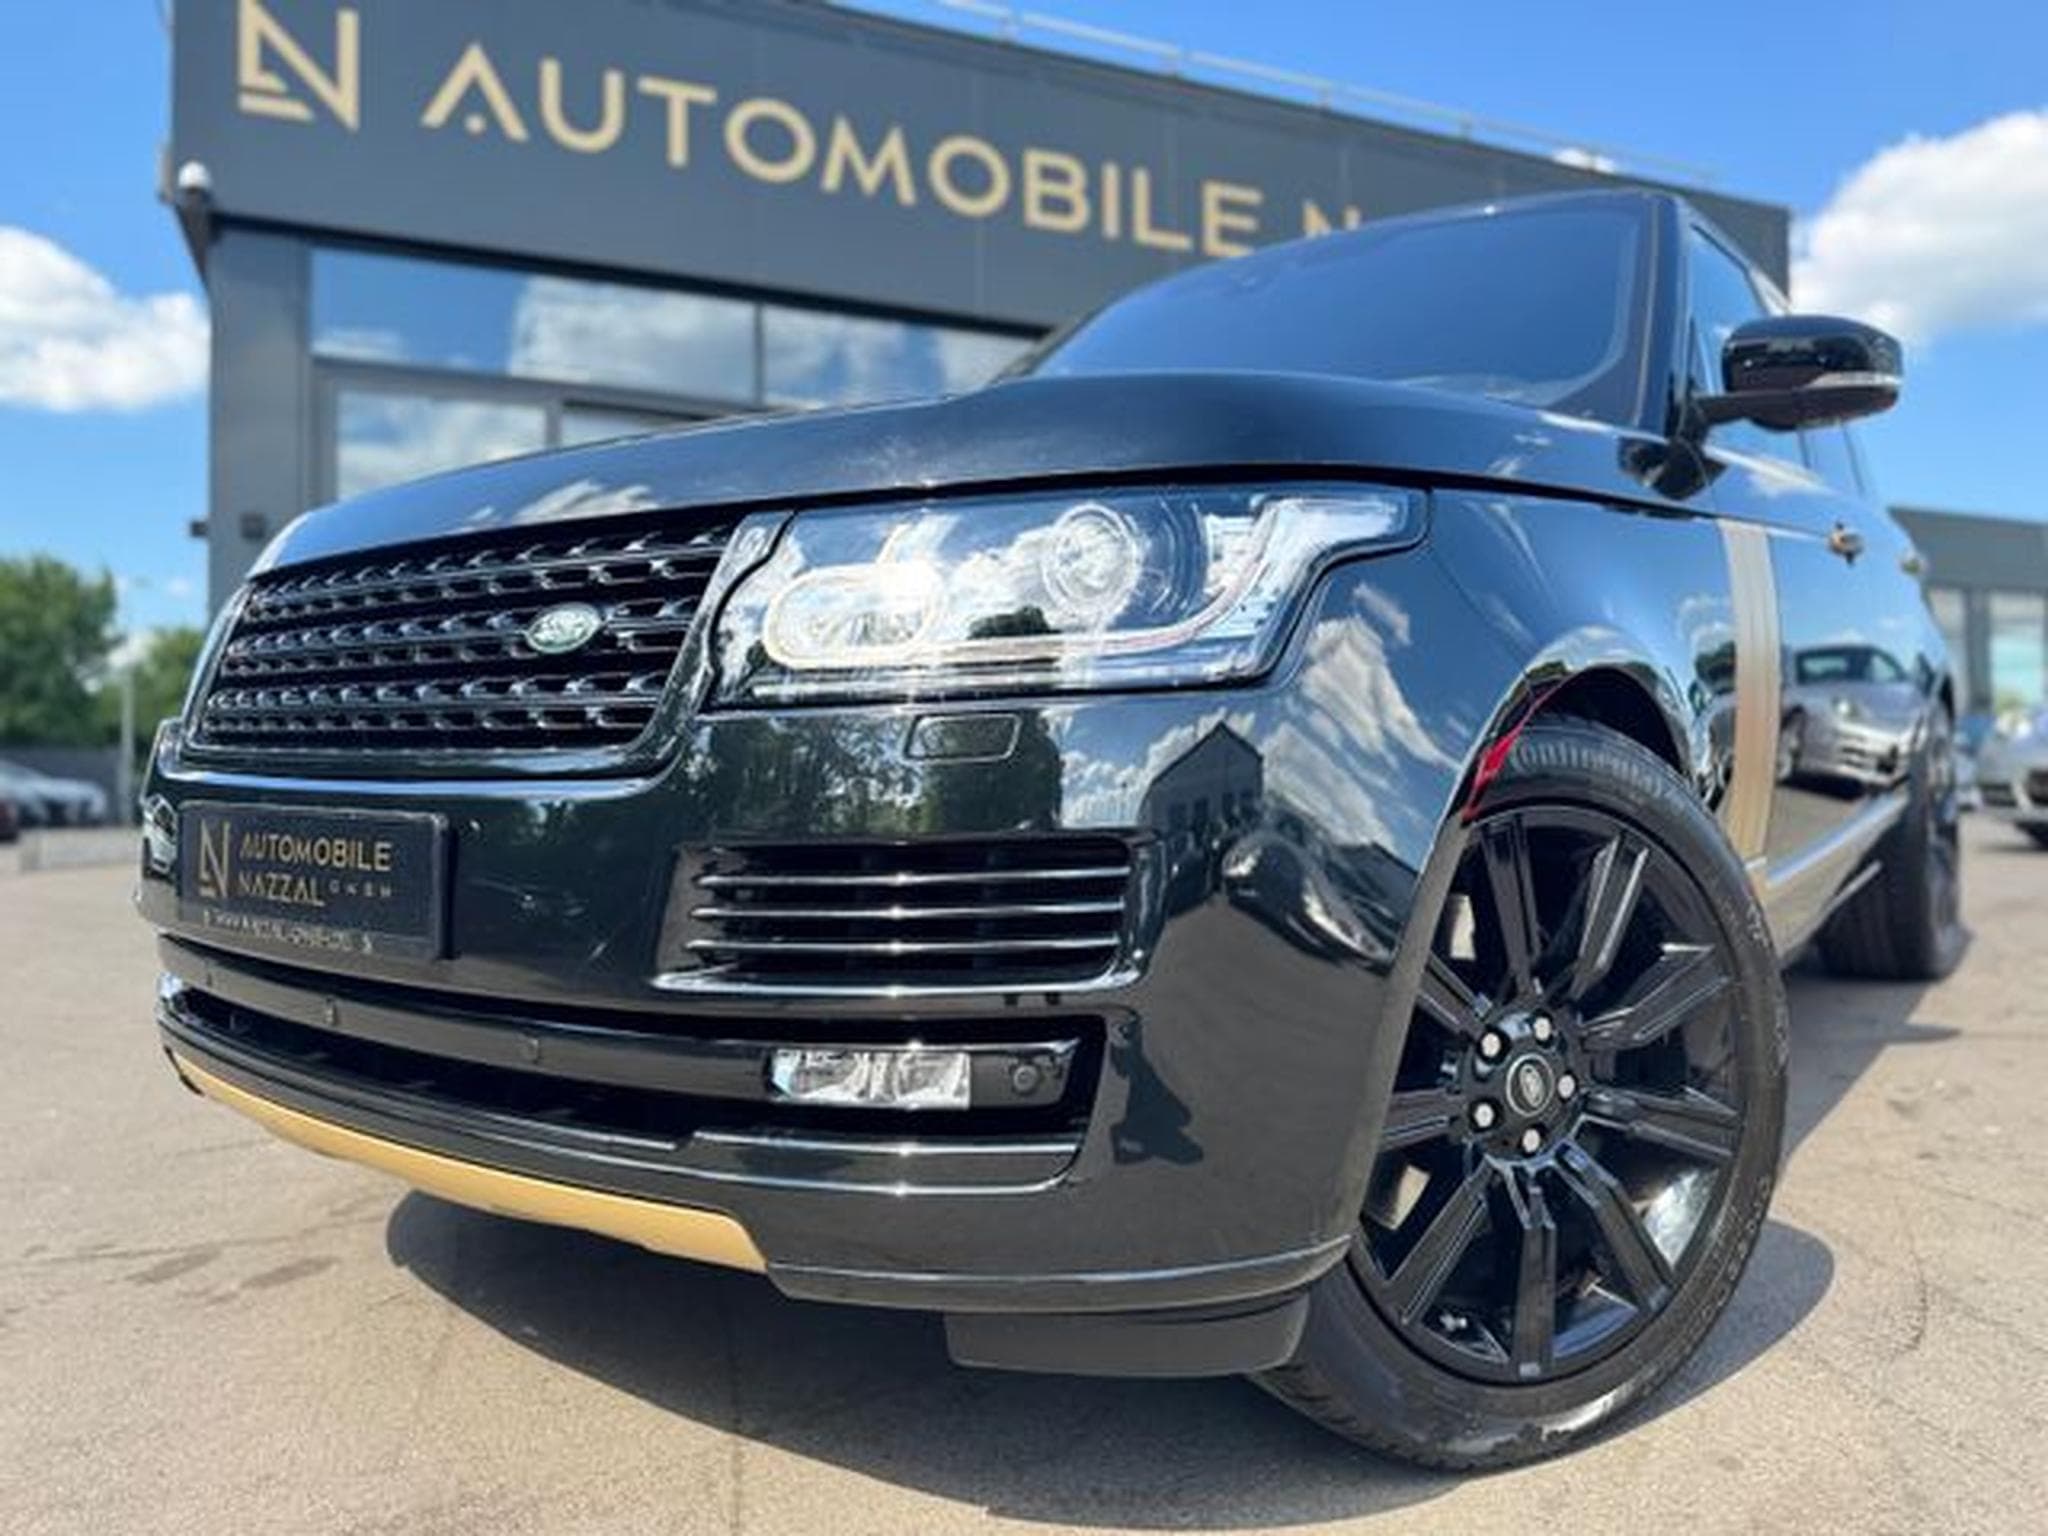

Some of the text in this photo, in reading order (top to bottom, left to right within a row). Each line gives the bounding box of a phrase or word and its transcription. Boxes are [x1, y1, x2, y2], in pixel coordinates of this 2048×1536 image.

[420, 42, 1263, 258] AUTOMOBILE
[239, 832, 393, 872] AUTOMOBILE
[239, 869, 326, 907] NAZZAL
